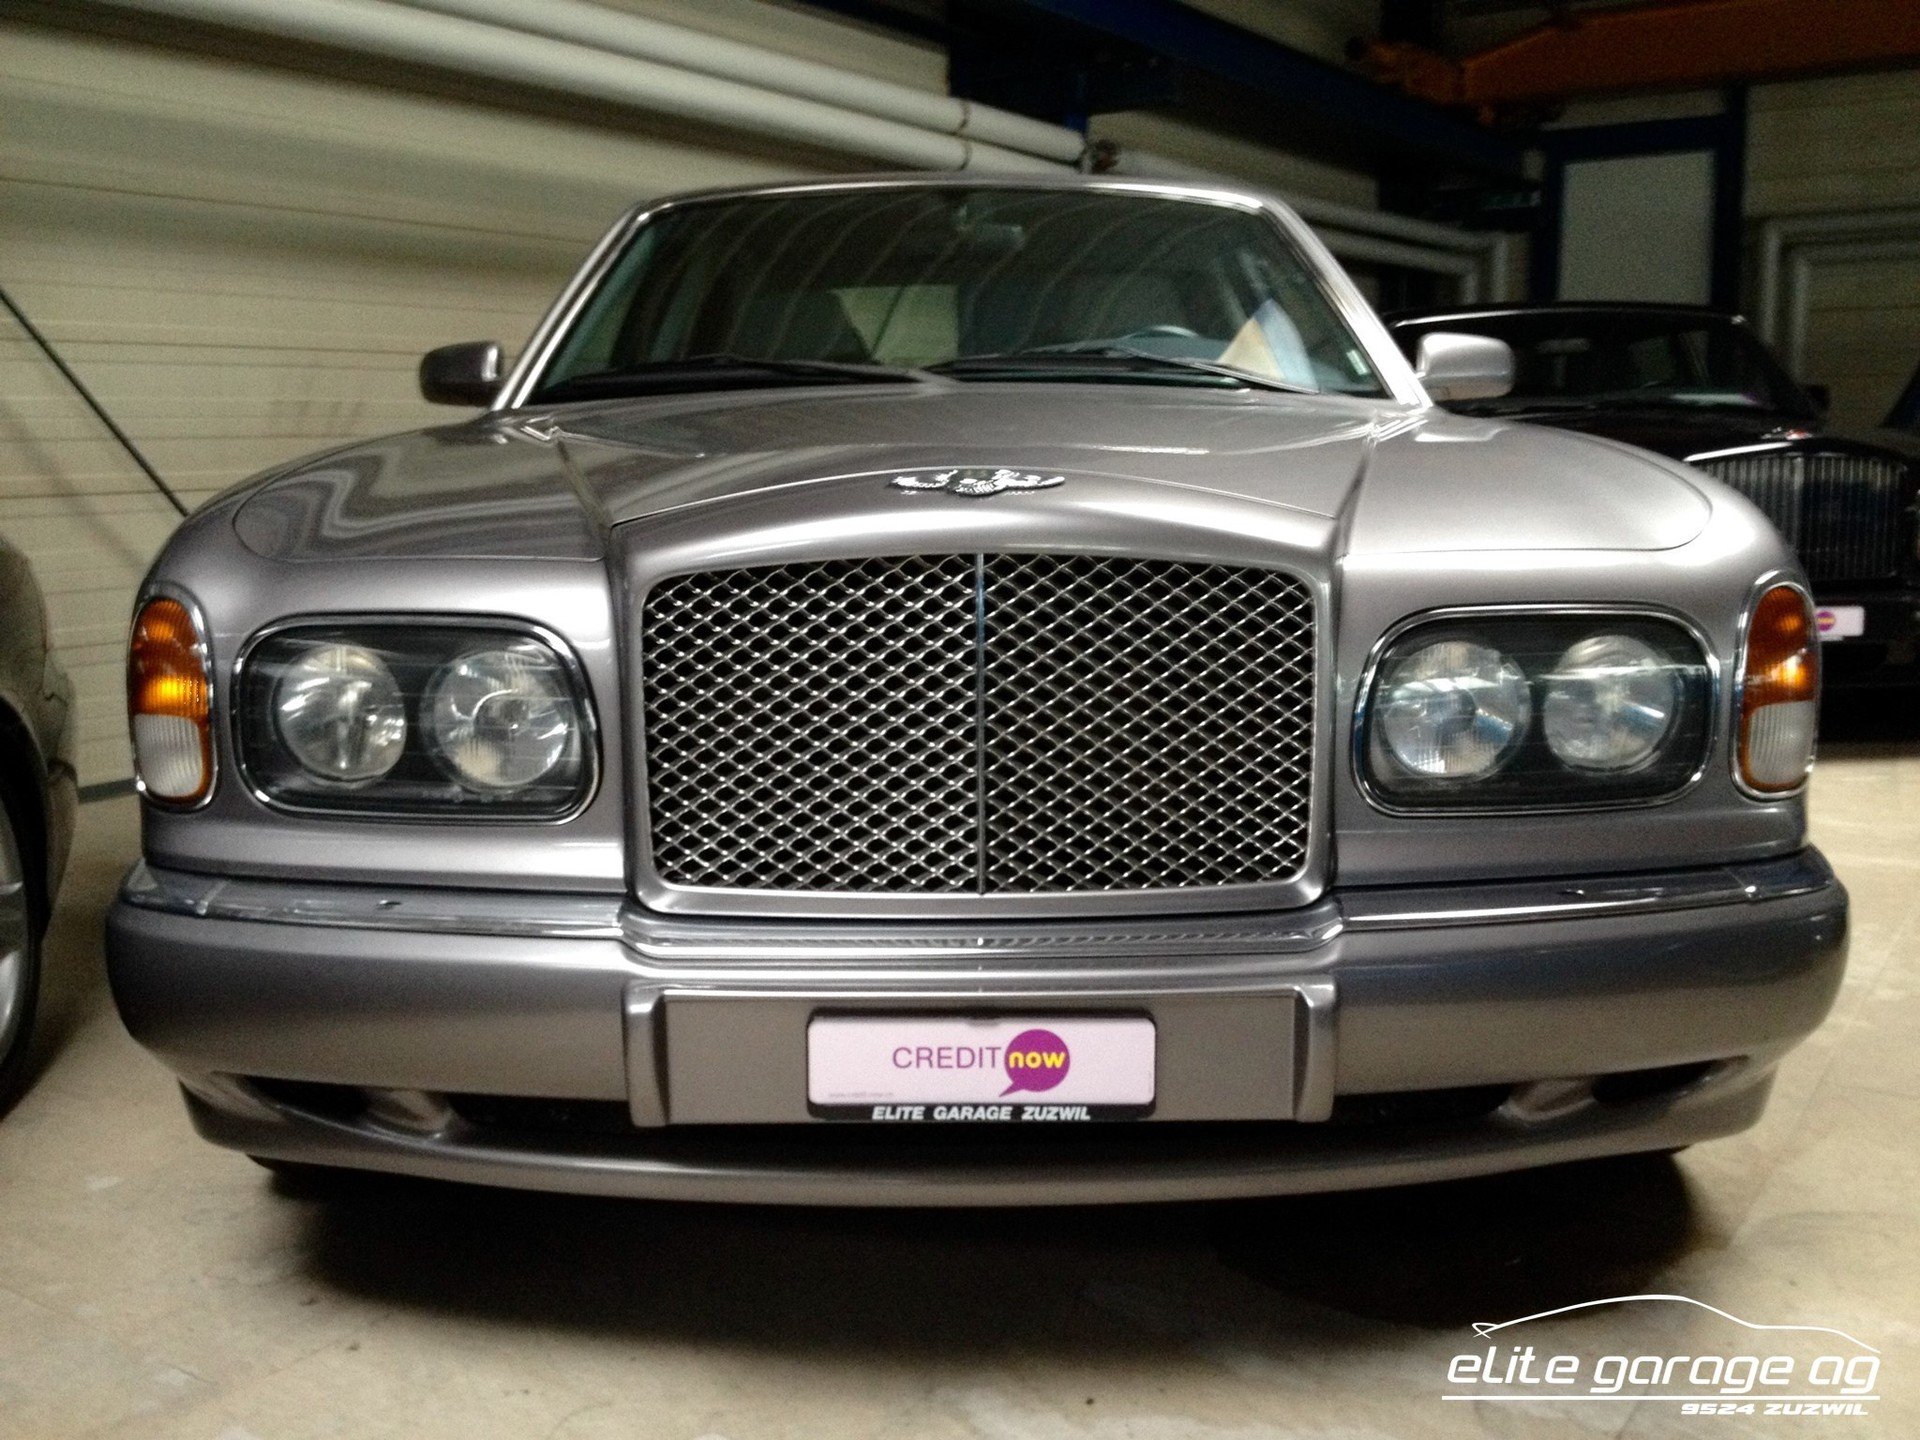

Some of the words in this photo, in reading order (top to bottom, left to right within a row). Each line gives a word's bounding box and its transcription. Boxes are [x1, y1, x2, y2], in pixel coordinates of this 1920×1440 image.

[892, 1047, 1001, 1069] CREDIT
[1008, 1051, 1066, 1069] now
[872, 1106, 924, 1120] ELITE
[933, 1106, 1012, 1120] GARAGE
[1021, 1106, 1091, 1120] ZUZWIL
